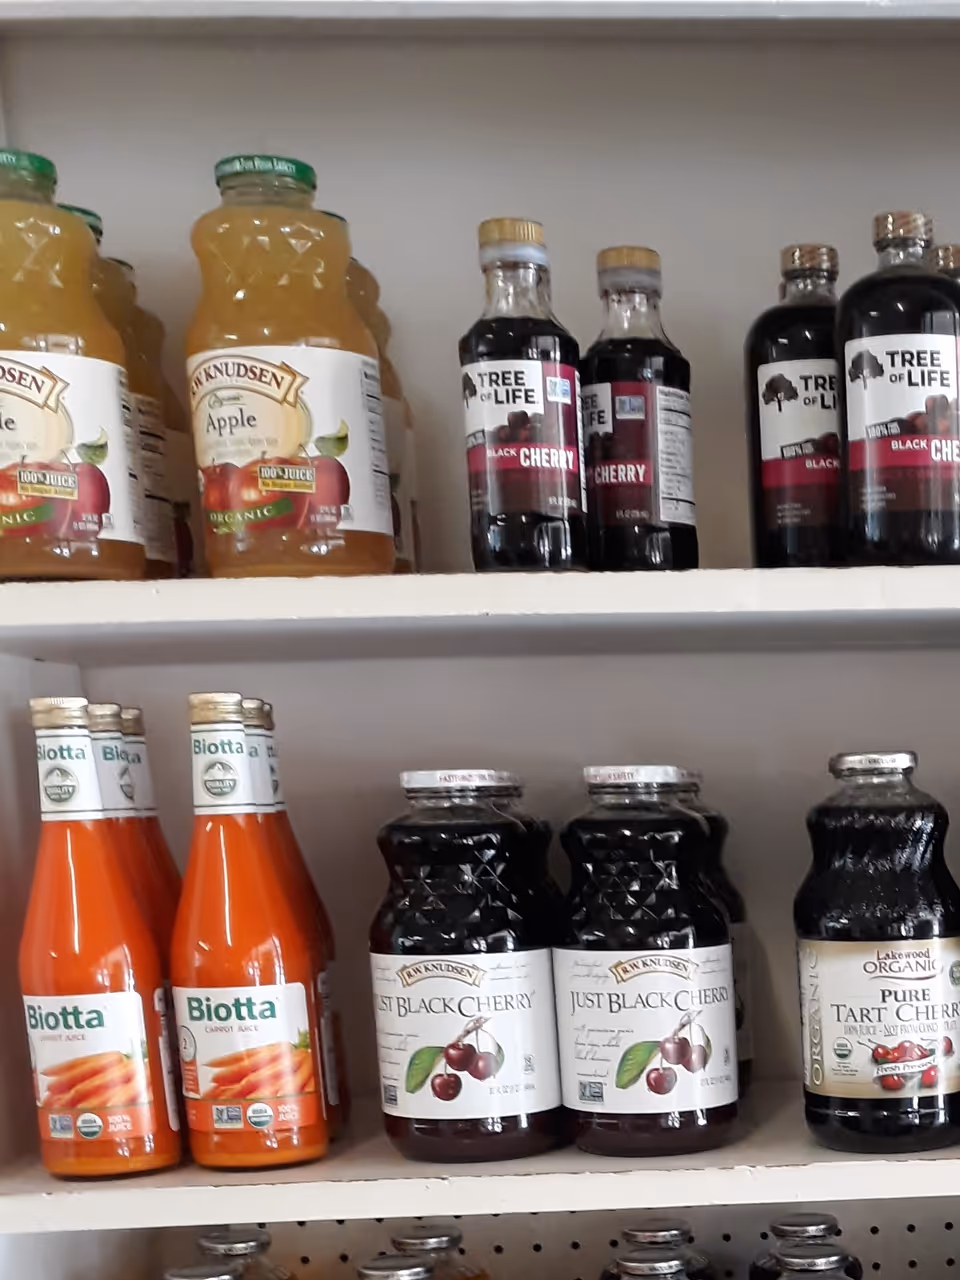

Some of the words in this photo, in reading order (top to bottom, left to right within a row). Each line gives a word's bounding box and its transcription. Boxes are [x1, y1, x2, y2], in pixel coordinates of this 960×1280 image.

[885, 350, 942, 368] TREE
[204, 361, 285, 390] KNUDSEN
[477, 370, 526, 387] TREE
[889, 373, 905, 384] OF
[907, 370, 951, 388] LIFE
[494, 388, 536, 405] LIFE
[206, 407, 257, 437] Apple
[891, 438, 928, 450] BLACK
[519, 447, 575, 469] CHERRY
[594, 463, 647, 484] CHERRY
[208, 505, 274, 523] ORGANIC
[193, 738, 245, 755] Biotta
[877, 947, 931, 960] Lakewood
[423, 962, 474, 979] KNUDSEN
[641, 957, 690, 973] KNUDSEN
[396, 996, 457, 1018] BLACK
[457, 991, 534, 1018] CHERRY
[570, 990, 604, 1016] JUST
[606, 992, 674, 1014] BLACK
[880, 988, 931, 1004] PURE
[28, 1004, 105, 1030] Biotta
[187, 995, 277, 1022] Biotta
[830, 1003, 889, 1023] TART
